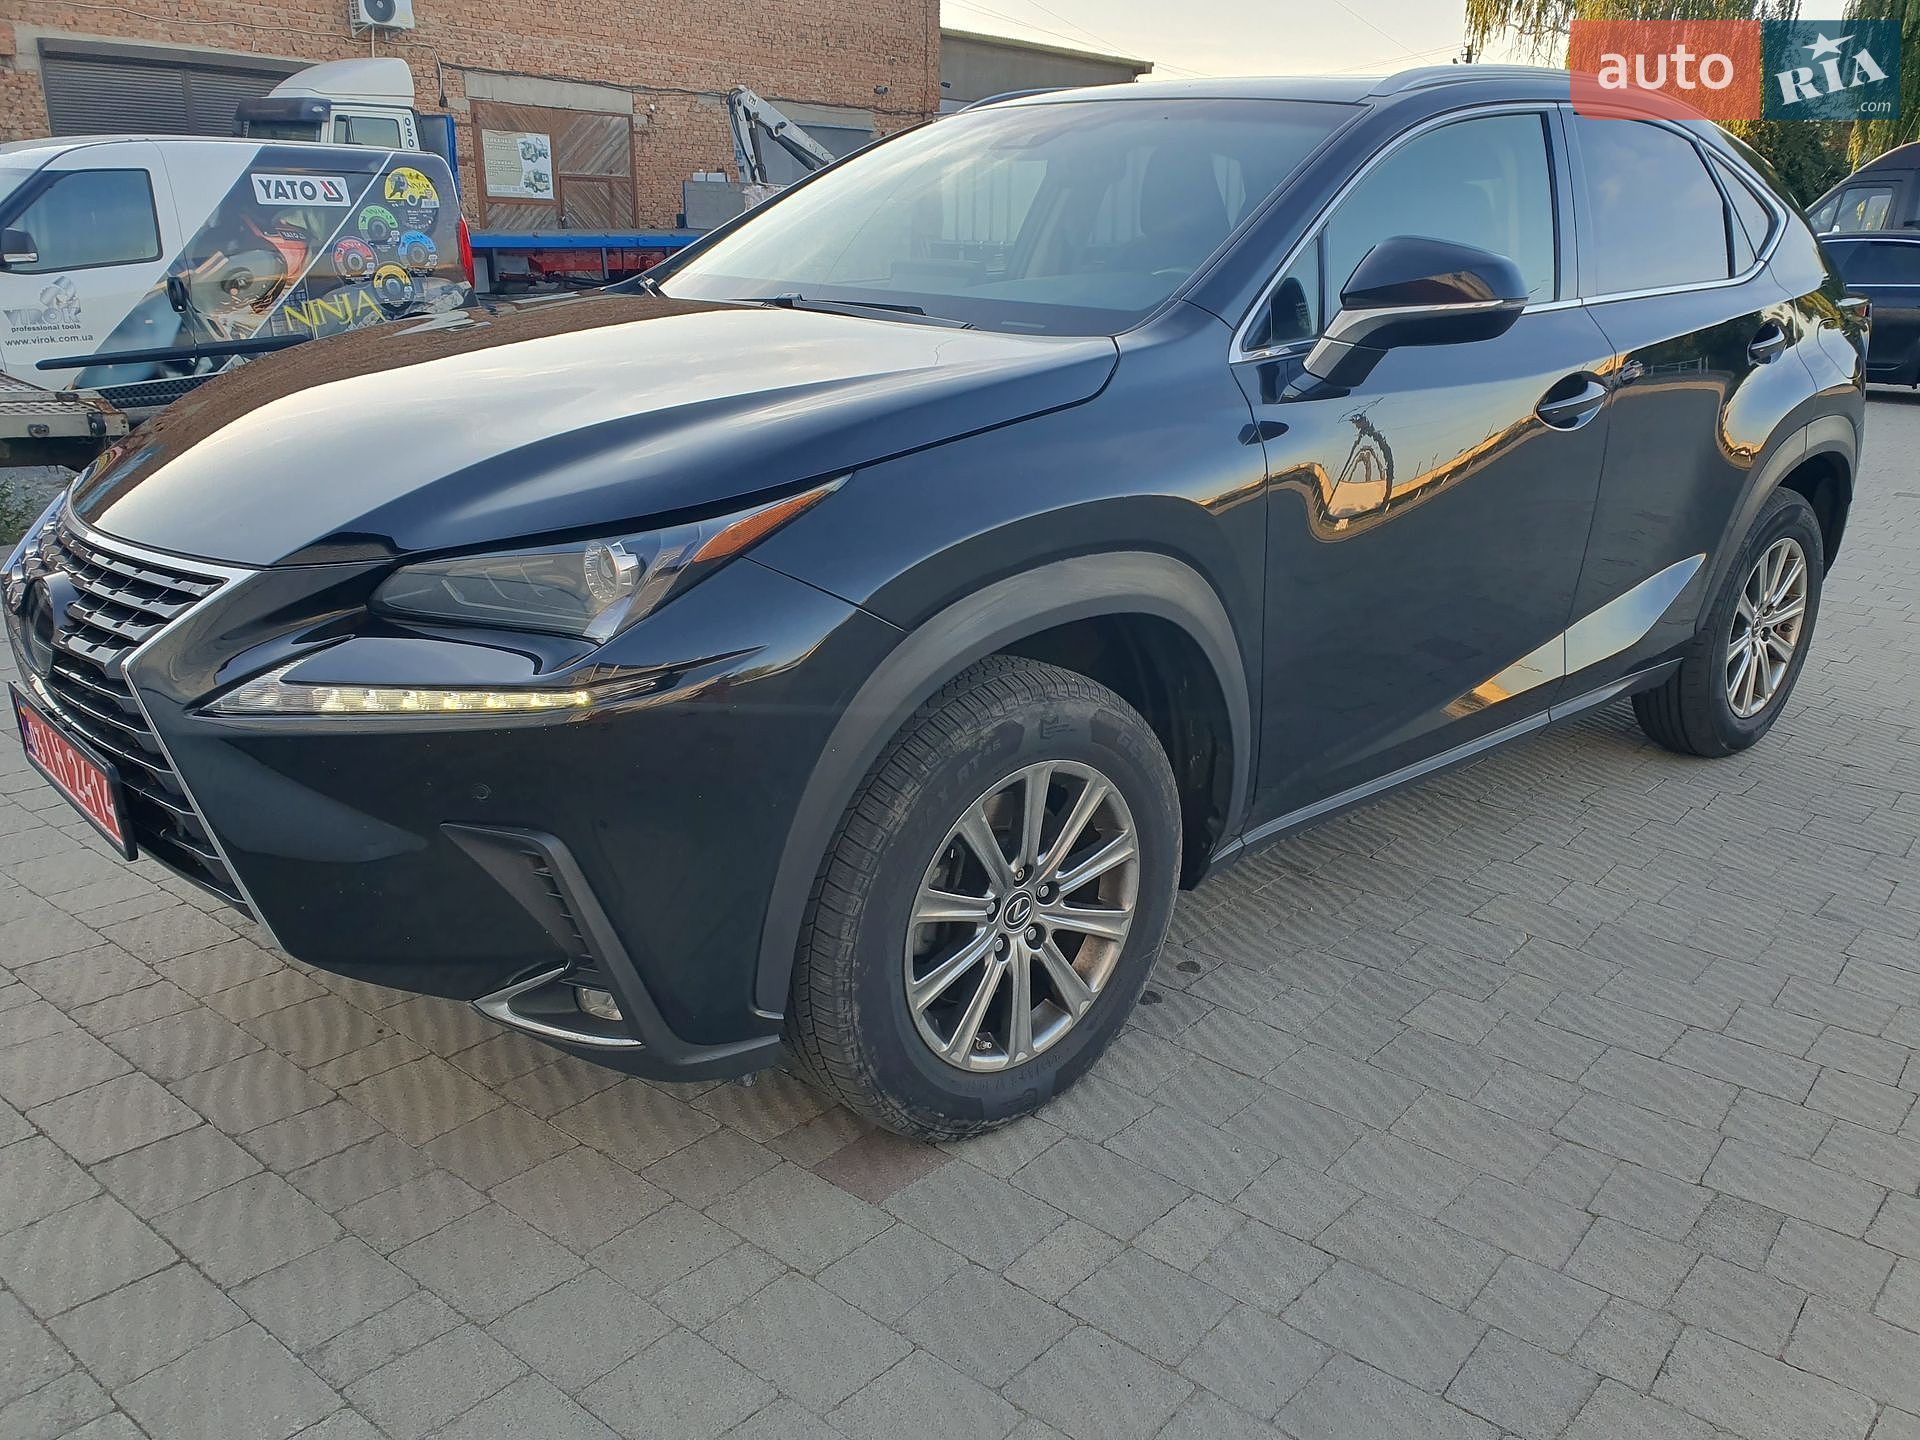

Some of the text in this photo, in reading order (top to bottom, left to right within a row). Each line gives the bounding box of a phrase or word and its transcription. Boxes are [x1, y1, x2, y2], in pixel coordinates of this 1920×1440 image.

[257, 179, 317, 201] YATO
[3, 308, 81, 326] VIROK
[283, 290, 386, 332] NINJA
[11, 325, 60, 333] professional
[5, 334, 94, 346] www.virok.com.ua
[66, 748, 120, 833] 2414
